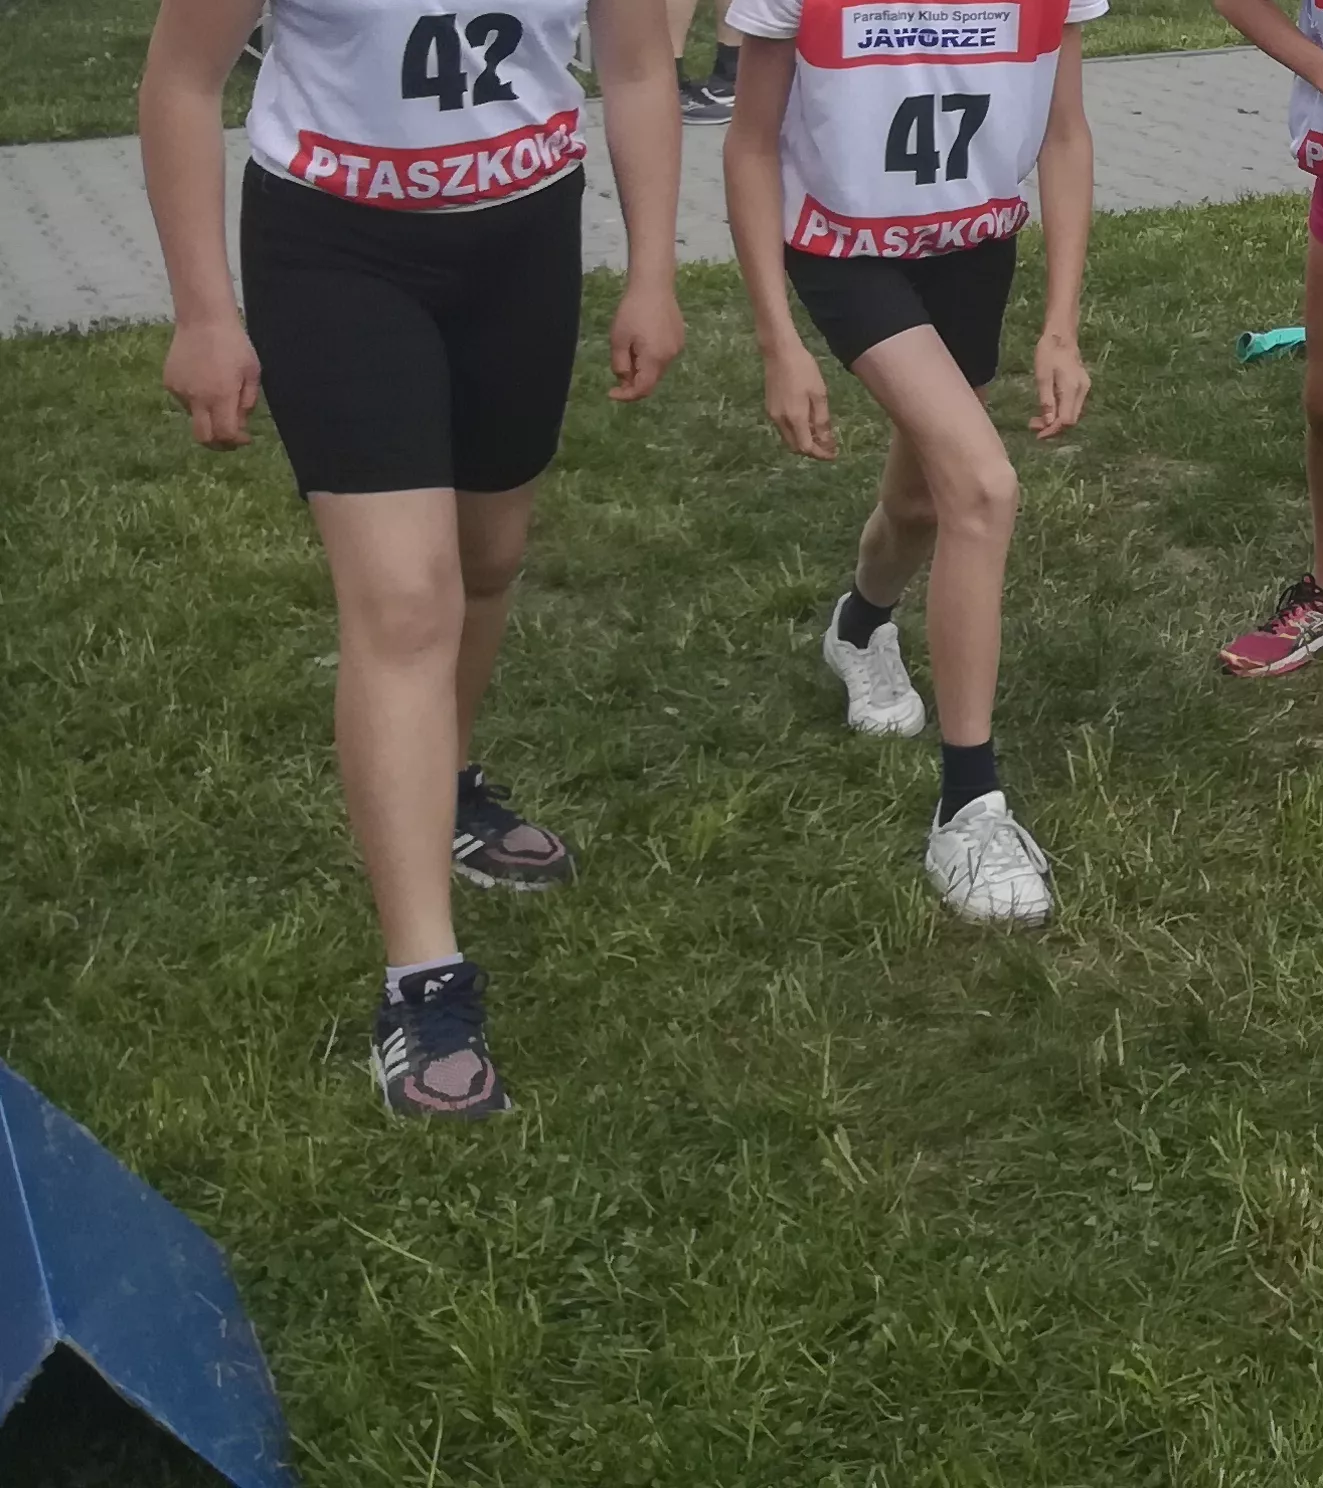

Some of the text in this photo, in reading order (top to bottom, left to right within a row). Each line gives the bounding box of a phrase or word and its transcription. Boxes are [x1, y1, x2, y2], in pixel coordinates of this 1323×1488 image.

[853, 10, 1011, 24] Parafialny Klub Sportowy
[858, 27, 997, 49] JAWORZE
[402, 12, 523, 112] 42
[885, 94, 991, 185] 47
